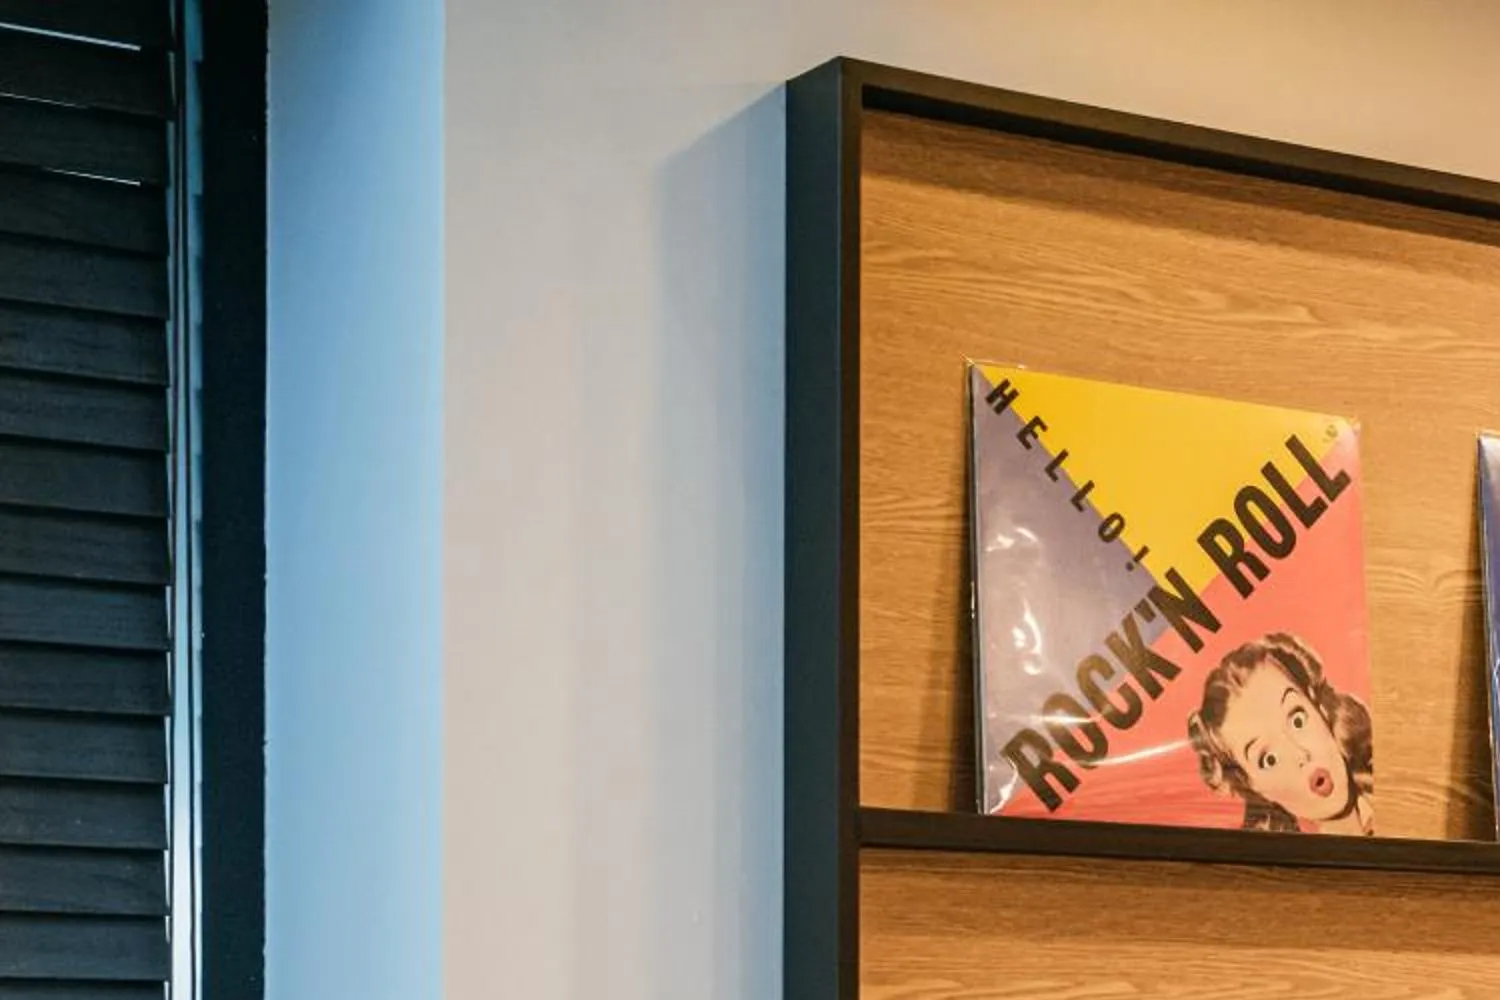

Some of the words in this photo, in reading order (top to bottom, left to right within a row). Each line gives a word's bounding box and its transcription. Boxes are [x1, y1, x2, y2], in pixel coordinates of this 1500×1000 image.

[985, 378, 1149, 571] HELLO!
[1000, 568, 1221, 812] ROCK'N
[1197, 434, 1351, 598] ROLL
